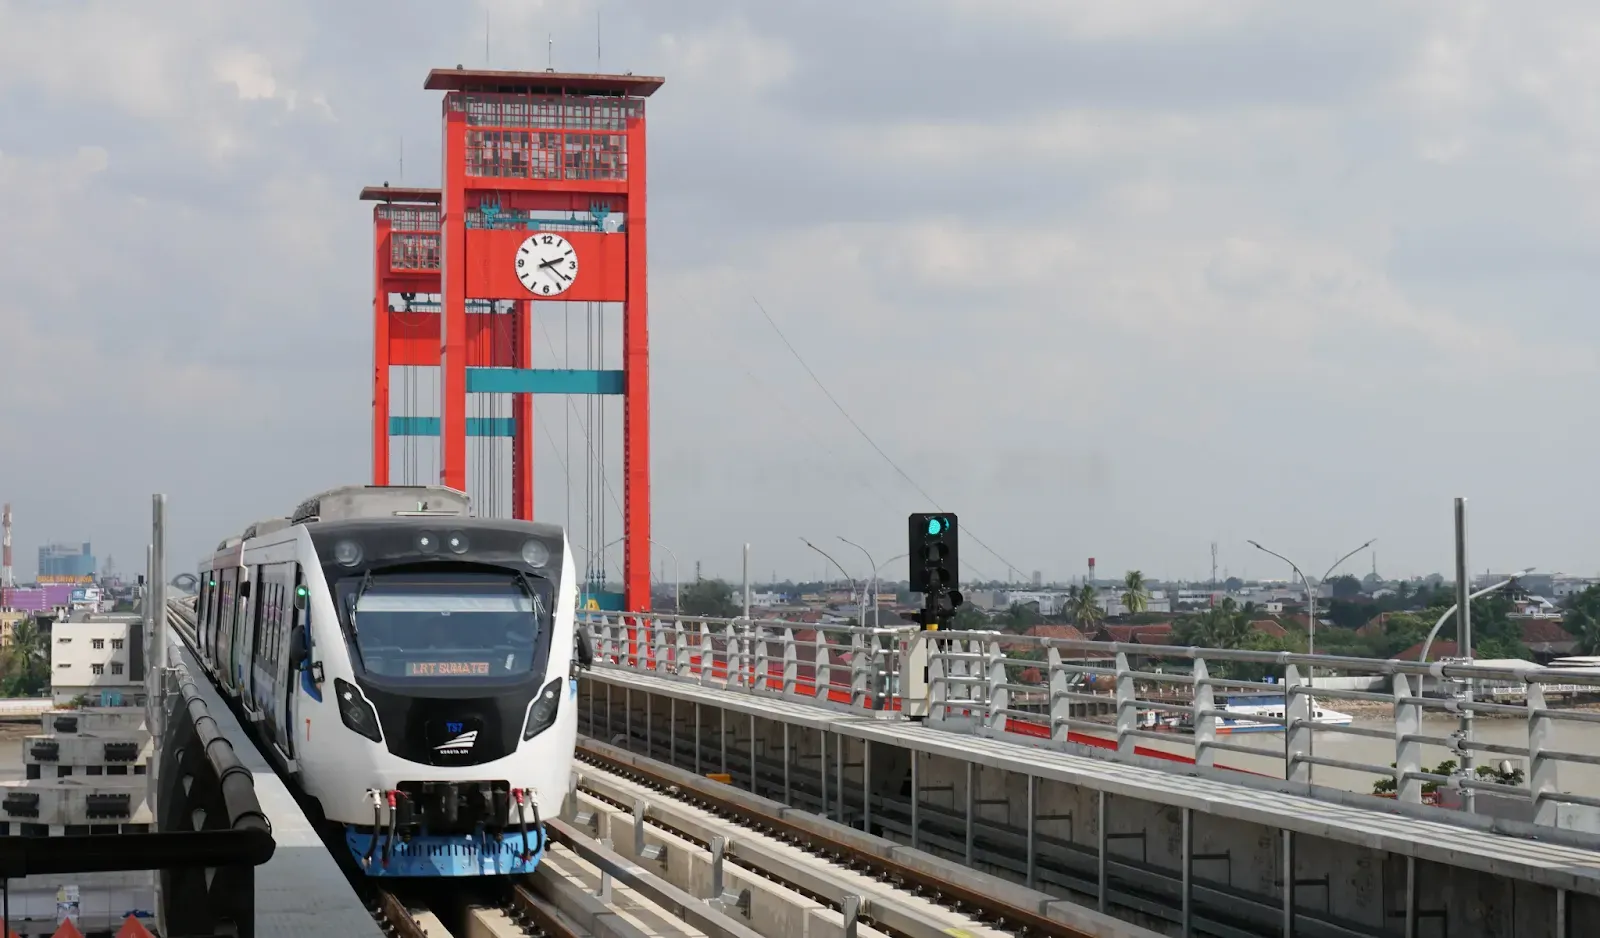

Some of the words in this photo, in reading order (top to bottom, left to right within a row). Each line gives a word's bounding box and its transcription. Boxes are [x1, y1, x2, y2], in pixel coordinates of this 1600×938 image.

[541, 235, 553, 244] 12
[517, 259, 525, 268] 9
[569, 261, 576, 269] 3
[542, 285, 550, 294] 6
[413, 662, 436, 674] LRT
[446, 722, 463, 732] TS7
